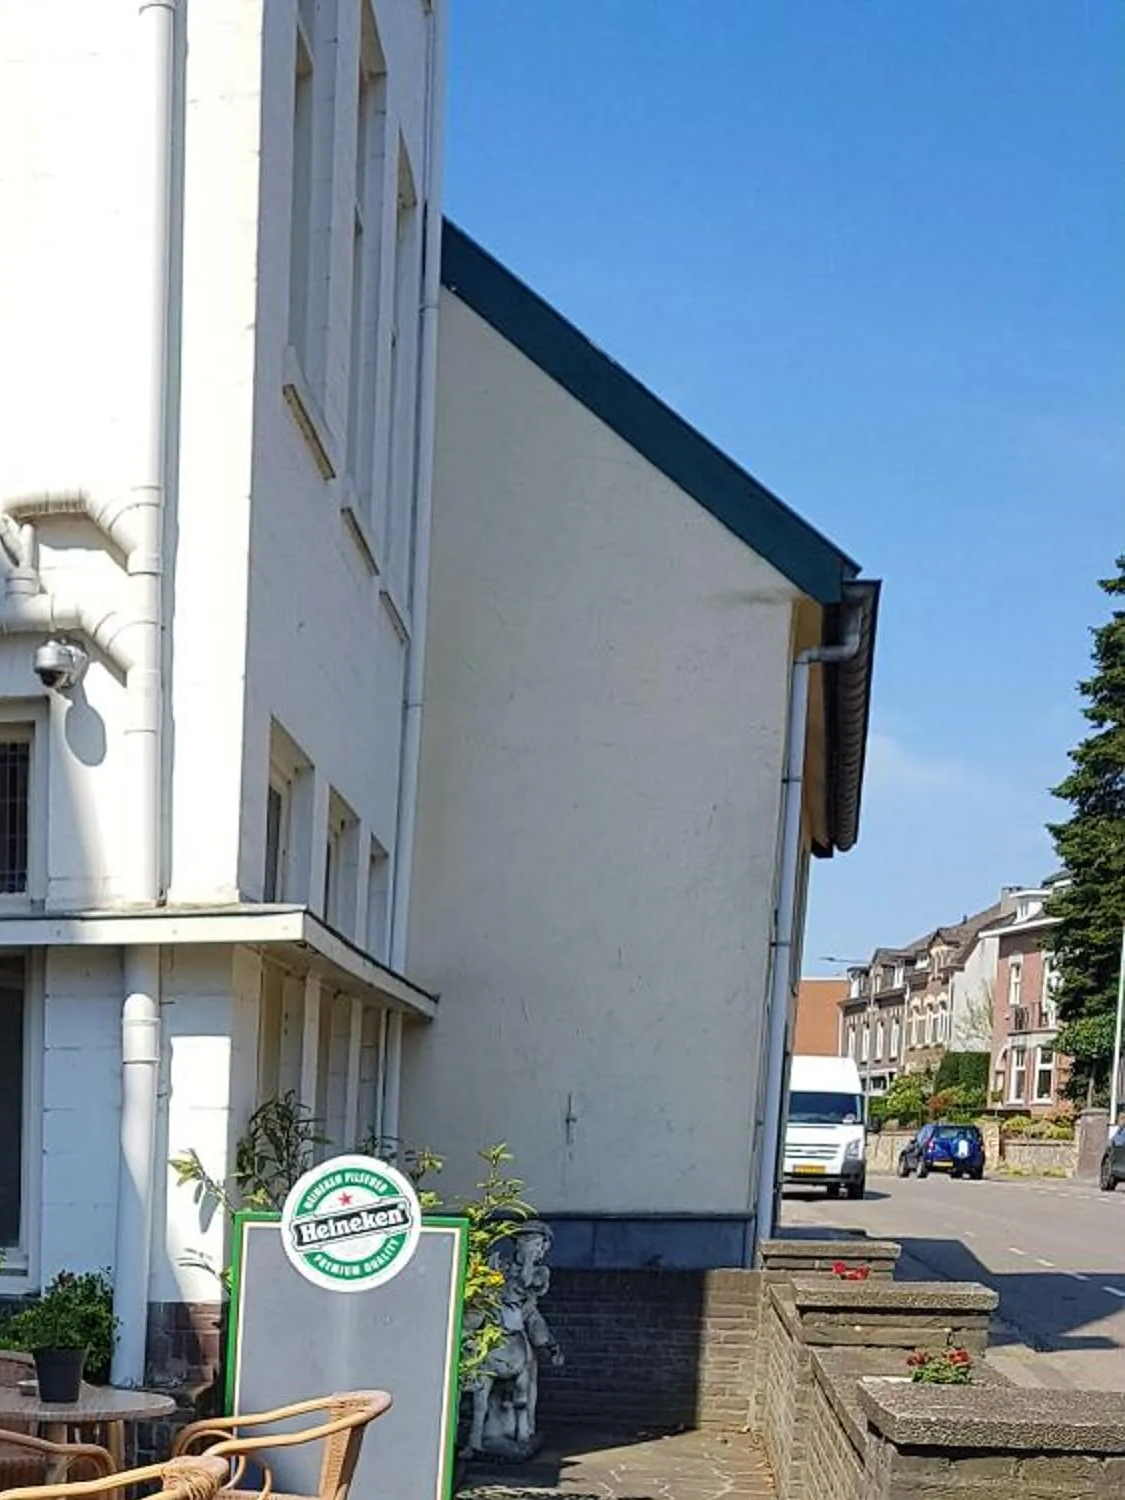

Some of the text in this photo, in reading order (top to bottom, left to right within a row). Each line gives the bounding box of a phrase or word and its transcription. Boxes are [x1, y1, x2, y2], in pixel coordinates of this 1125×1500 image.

[299, 1207, 404, 1243] Heineken
[314, 1239, 400, 1276] PREMIUM QUALITY
